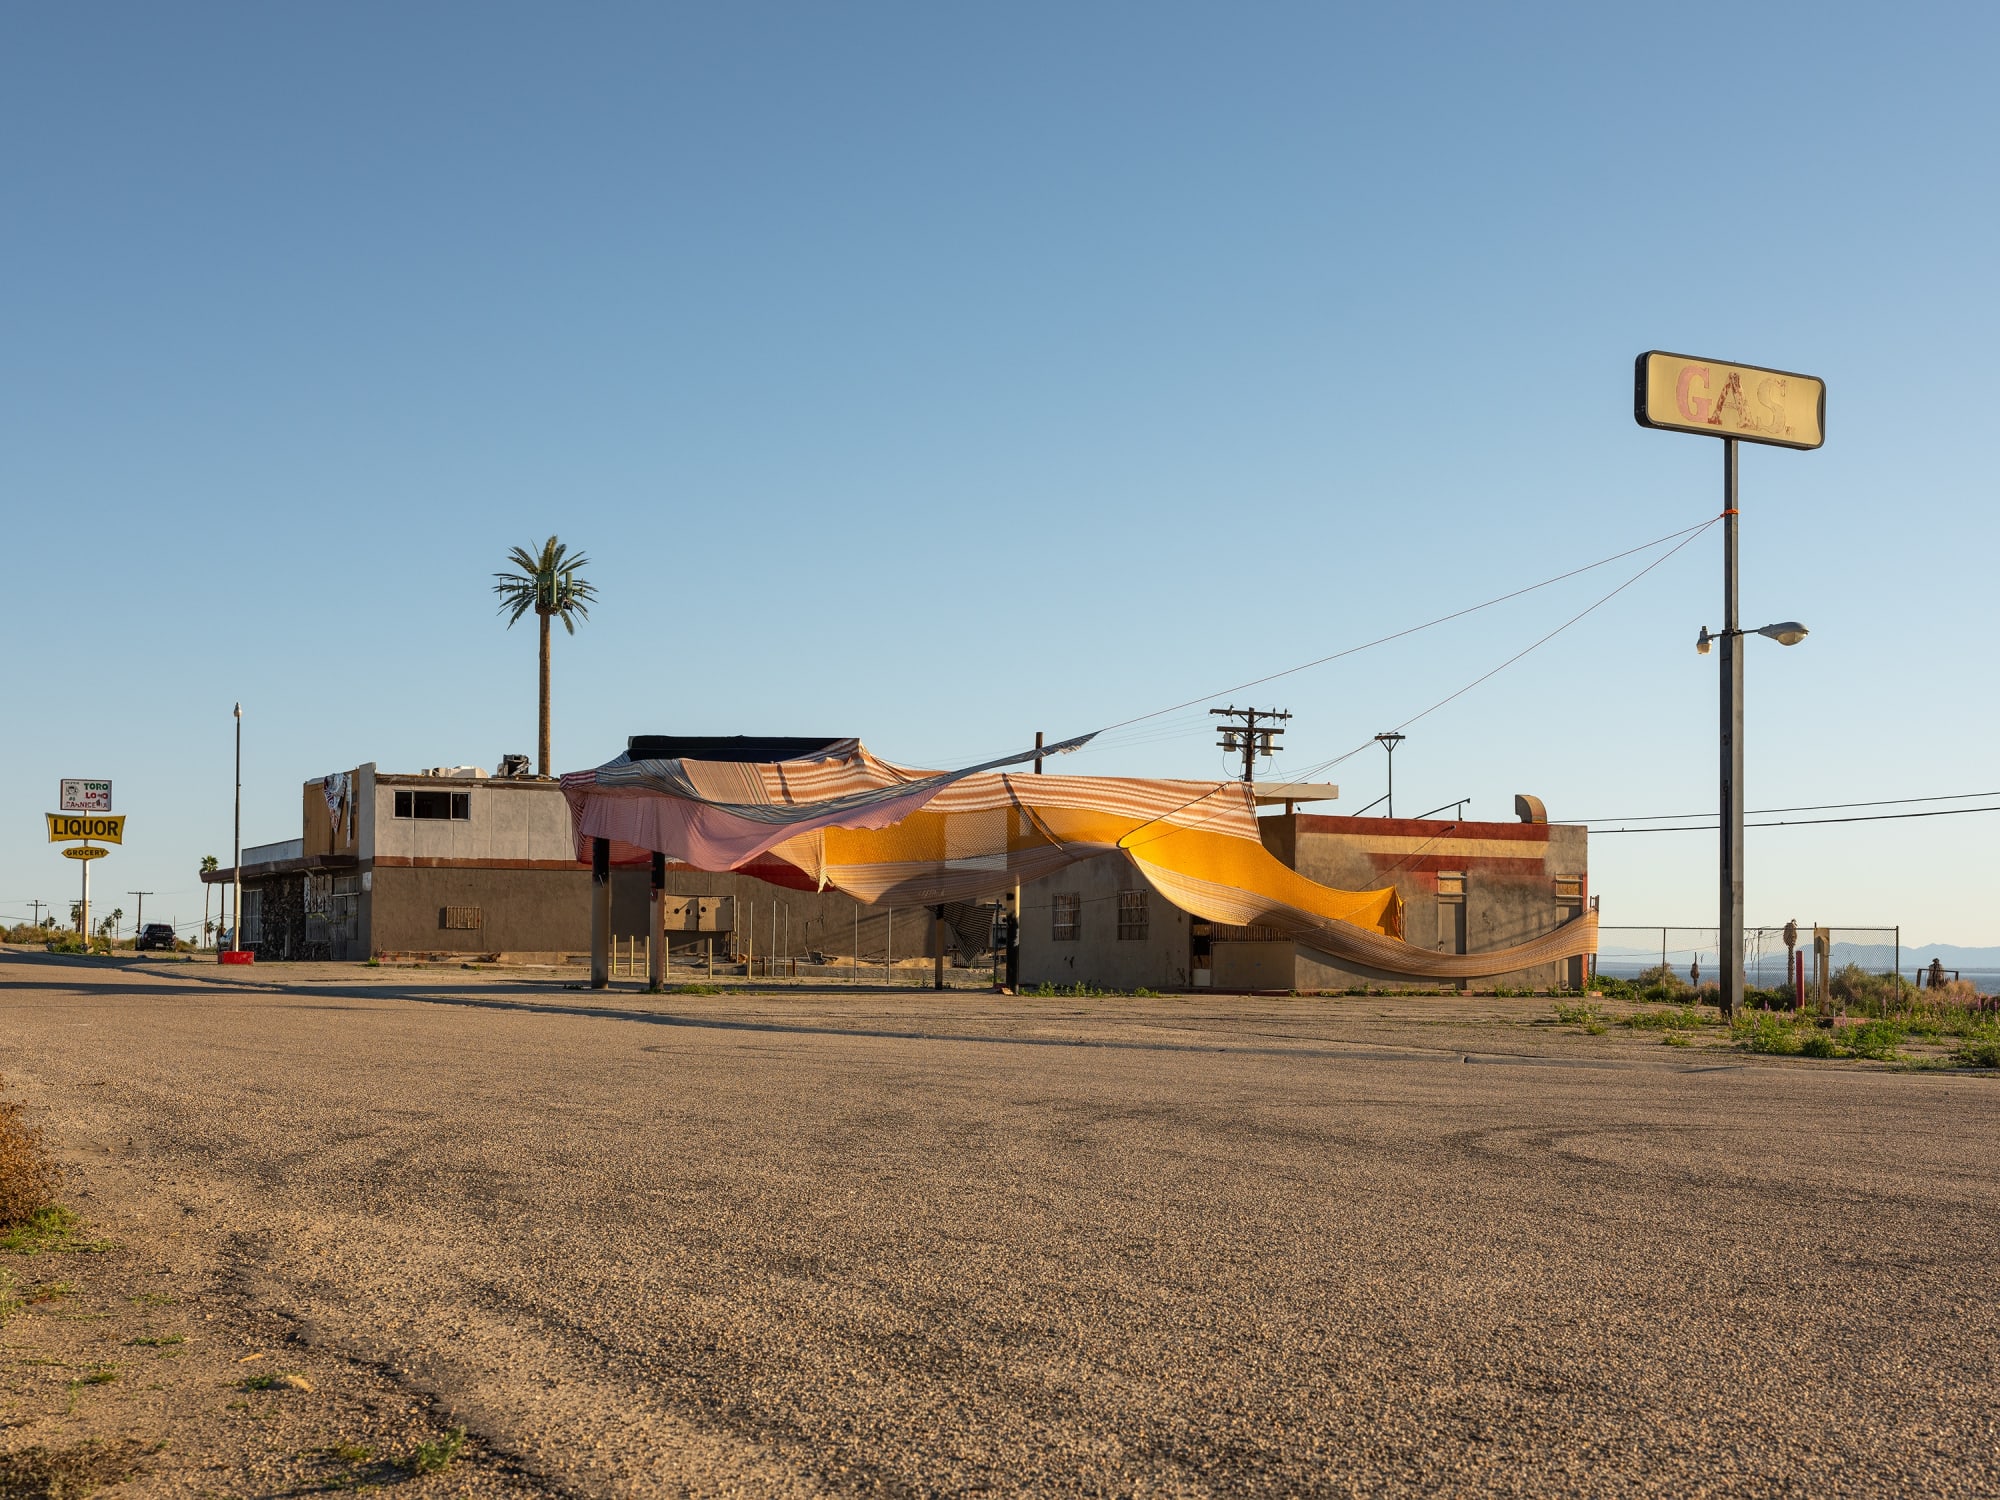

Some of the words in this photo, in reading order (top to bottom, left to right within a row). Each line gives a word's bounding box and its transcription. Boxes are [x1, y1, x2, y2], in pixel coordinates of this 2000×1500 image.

[1676, 365, 1787, 434] GAS
[84, 782, 108, 790] TORO
[53, 819, 118, 836] LIQUOR
